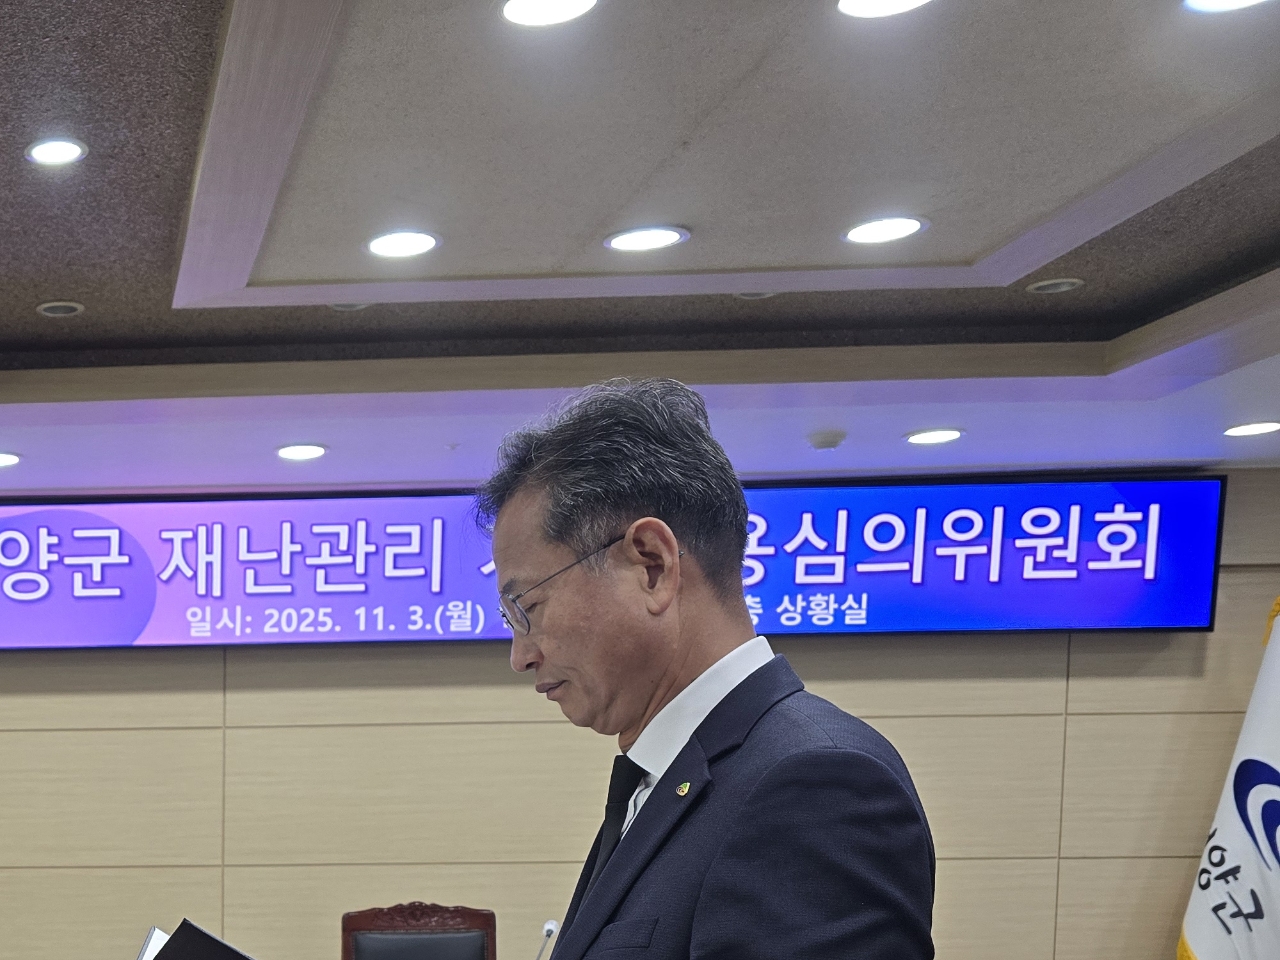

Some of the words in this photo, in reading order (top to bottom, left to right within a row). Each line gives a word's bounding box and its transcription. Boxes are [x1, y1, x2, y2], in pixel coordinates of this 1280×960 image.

[158, 517, 445, 598] 재난관리
[185, 604, 253, 637] 일시:
[263, 607, 342, 634] 2025.
[354, 606, 396, 632] 11.
[407, 600, 485, 635] 3.(월)
[775, 592, 868, 626] 상황실
[1198, 828, 1265, 935] 양군
